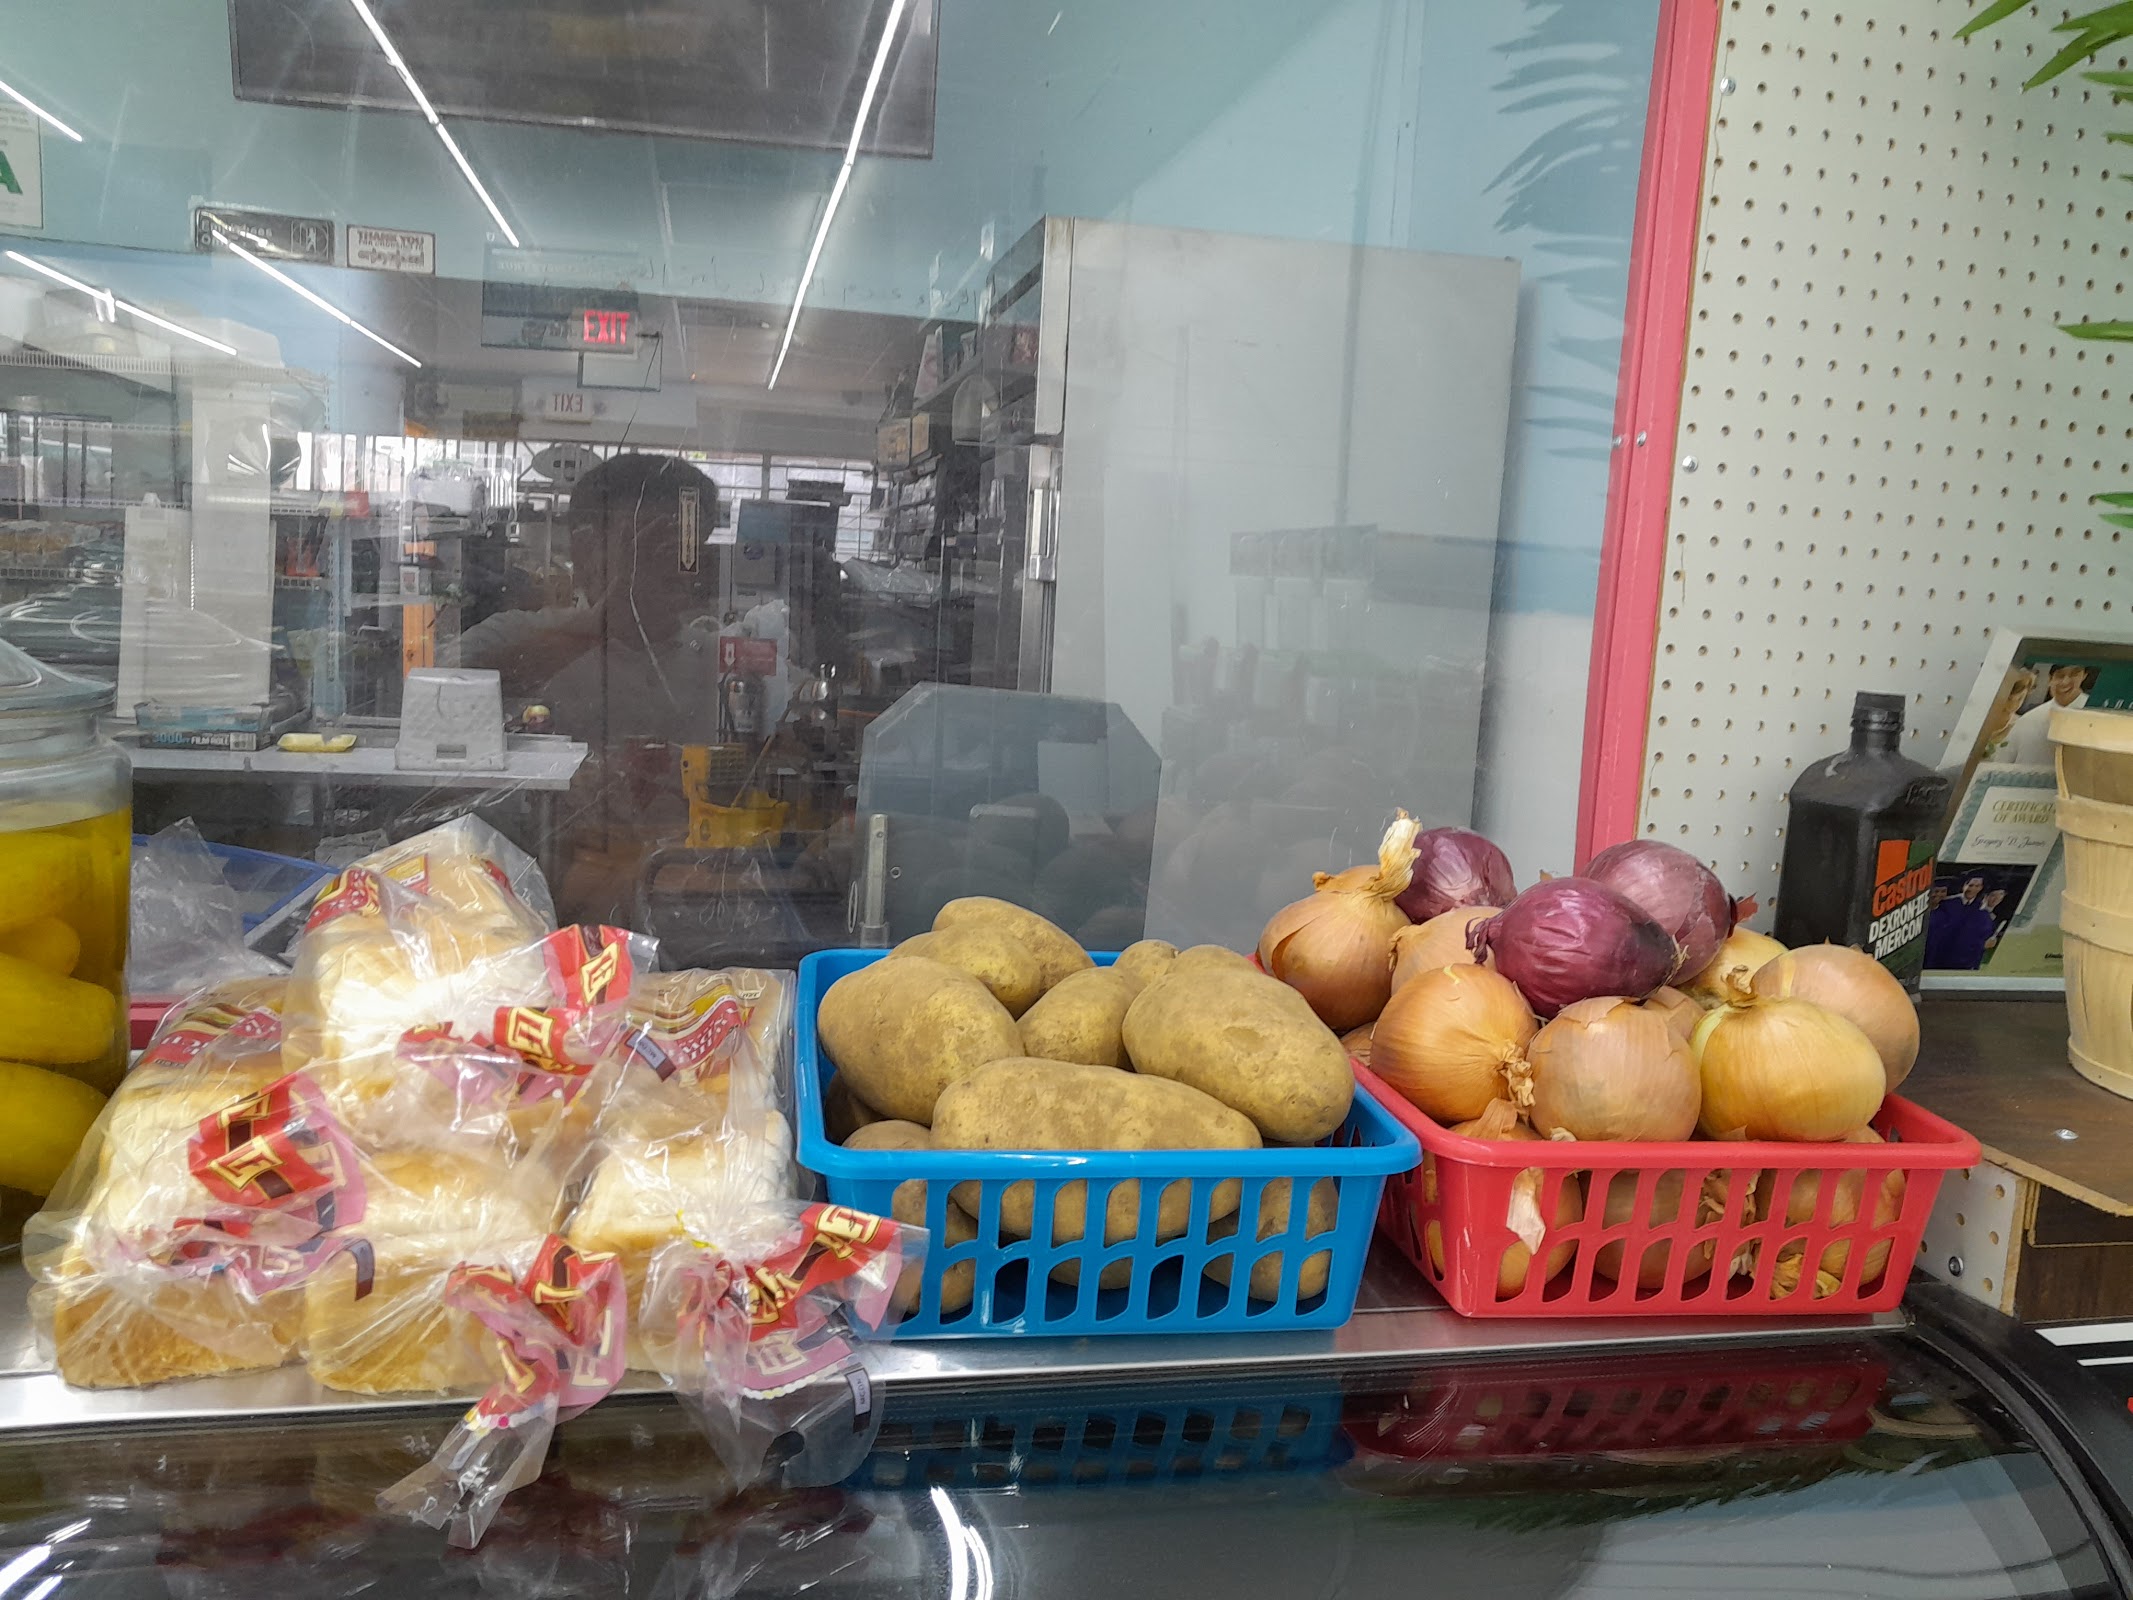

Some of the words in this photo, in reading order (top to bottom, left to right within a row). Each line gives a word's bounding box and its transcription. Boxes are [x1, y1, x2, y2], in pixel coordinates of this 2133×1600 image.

[583, 310, 630, 344] EXIT
[1992, 799, 2057, 814] CERTIFICAT
[1992, 811, 2008, 823] OF
[2010, 813, 2049, 824] AWARD
[1872, 857, 1933, 917] Castrol
[1875, 914, 1924, 960] MERCON
